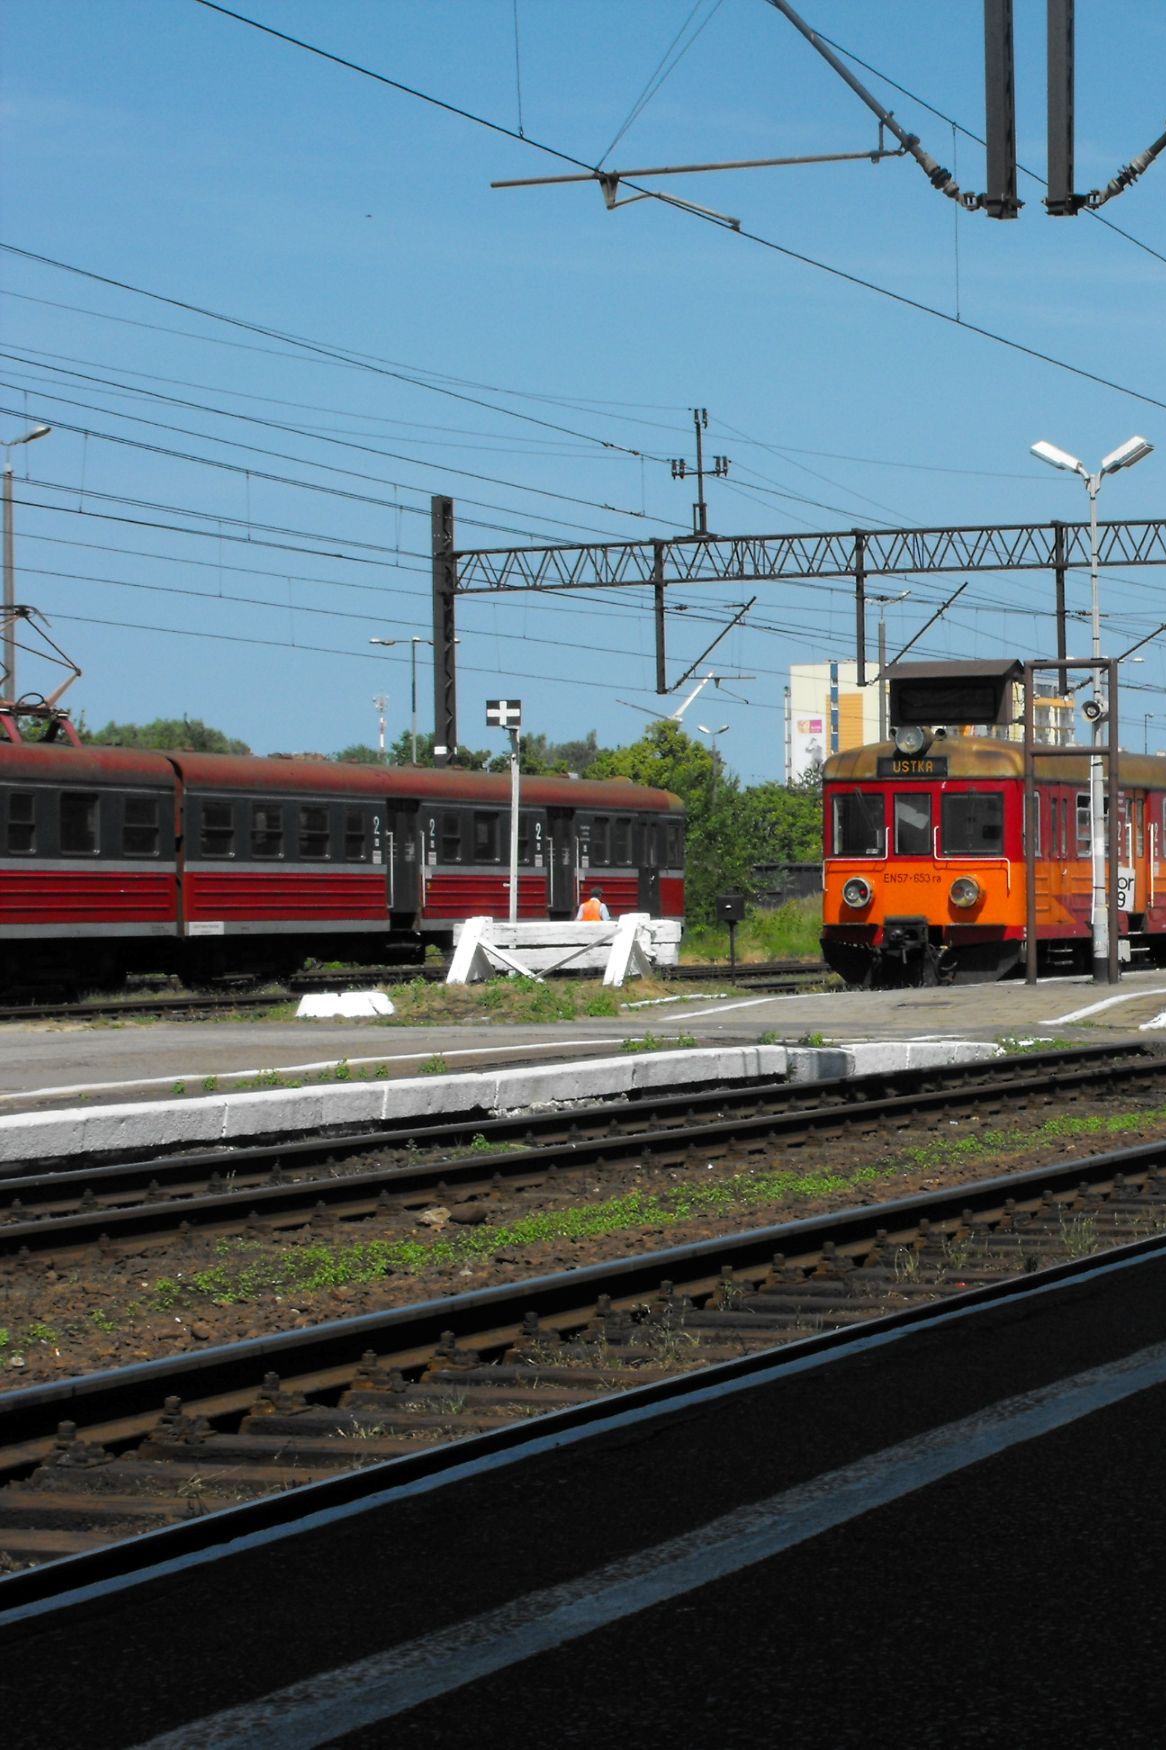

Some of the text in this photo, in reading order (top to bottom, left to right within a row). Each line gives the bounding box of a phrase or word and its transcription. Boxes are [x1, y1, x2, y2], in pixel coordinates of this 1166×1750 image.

[893, 760, 934, 773] USTKA
[373, 815, 380, 835] 2
[429, 818, 436, 837] 2
[535, 822, 542, 840] 2
